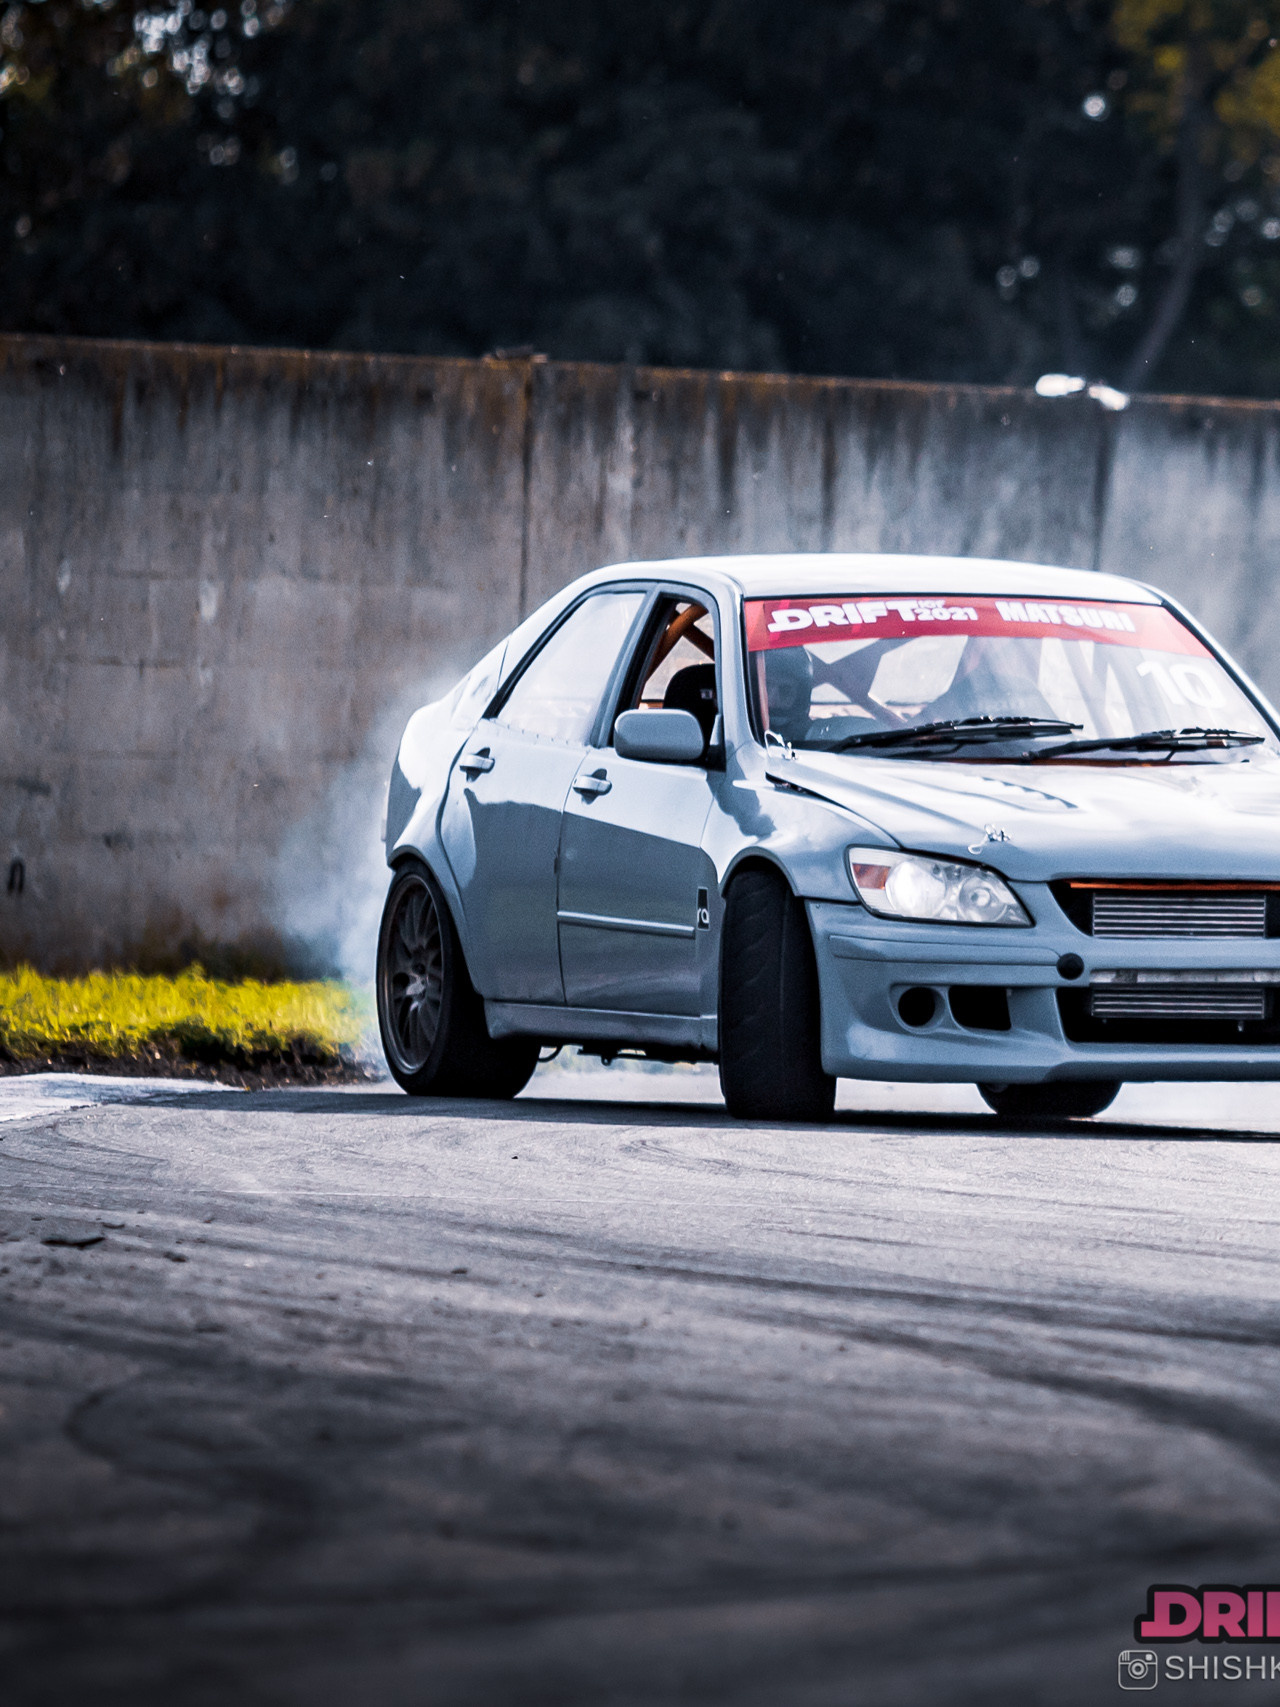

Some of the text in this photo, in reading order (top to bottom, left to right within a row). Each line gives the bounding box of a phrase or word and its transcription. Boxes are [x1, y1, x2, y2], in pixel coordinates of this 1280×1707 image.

[767, 600, 918, 633] DRIFT
[915, 607, 979, 622] 2021
[995, 601, 1136, 633] MATSURI
[1136, 661, 1227, 709] 10
